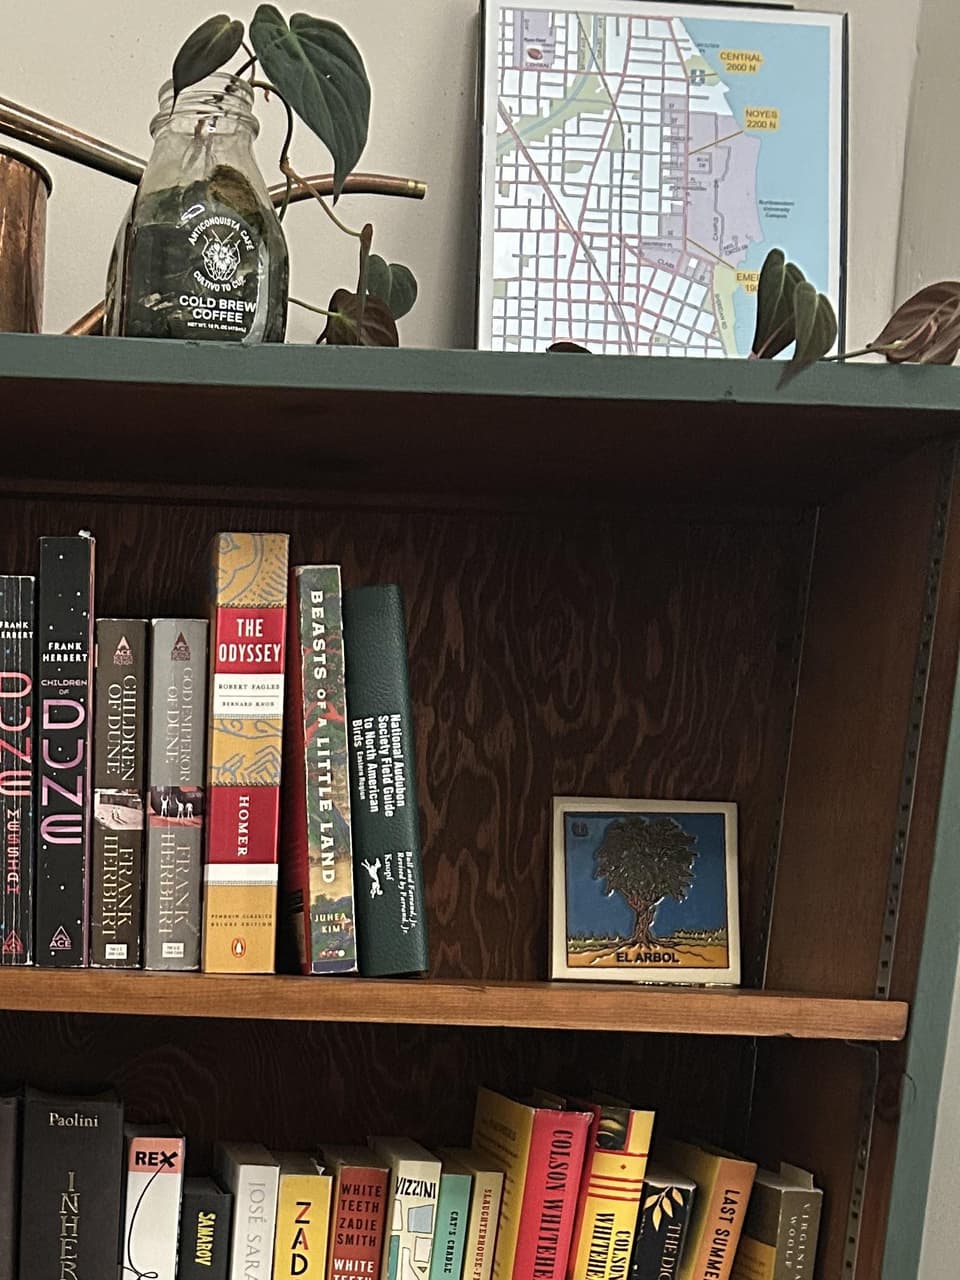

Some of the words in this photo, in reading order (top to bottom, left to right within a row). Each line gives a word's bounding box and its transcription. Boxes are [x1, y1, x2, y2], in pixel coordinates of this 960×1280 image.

[720, 52, 762, 62] CENTRAL
[749, 63, 756, 71] N
[745, 109, 778, 119] NOYES
[746, 120, 767, 128] 2200
[770, 120, 777, 128] N
[188, 216, 241, 246] ANTICONQUISTA
[194, 270, 221, 292] CULTIVO
[222, 283, 232, 292] TO
[179, 295, 216, 309] COLD
[218, 298, 257, 312] BREW
[192, 308, 243, 323] COFFEE
[236, 618, 264, 638] THE
[219, 643, 282, 663] ODYSSEY
[237, 795, 250, 857] HOMER
[314, 913, 348, 923] JUHEA
[321, 925, 341, 933] KIM
[616, 951, 633, 963] EL
[634, 951, 681, 964] ARBOL
[135, 1151, 178, 1169] REX
[545, 1129, 574, 1192] COLSON
[334, 1259, 374, 1273] WHITE
